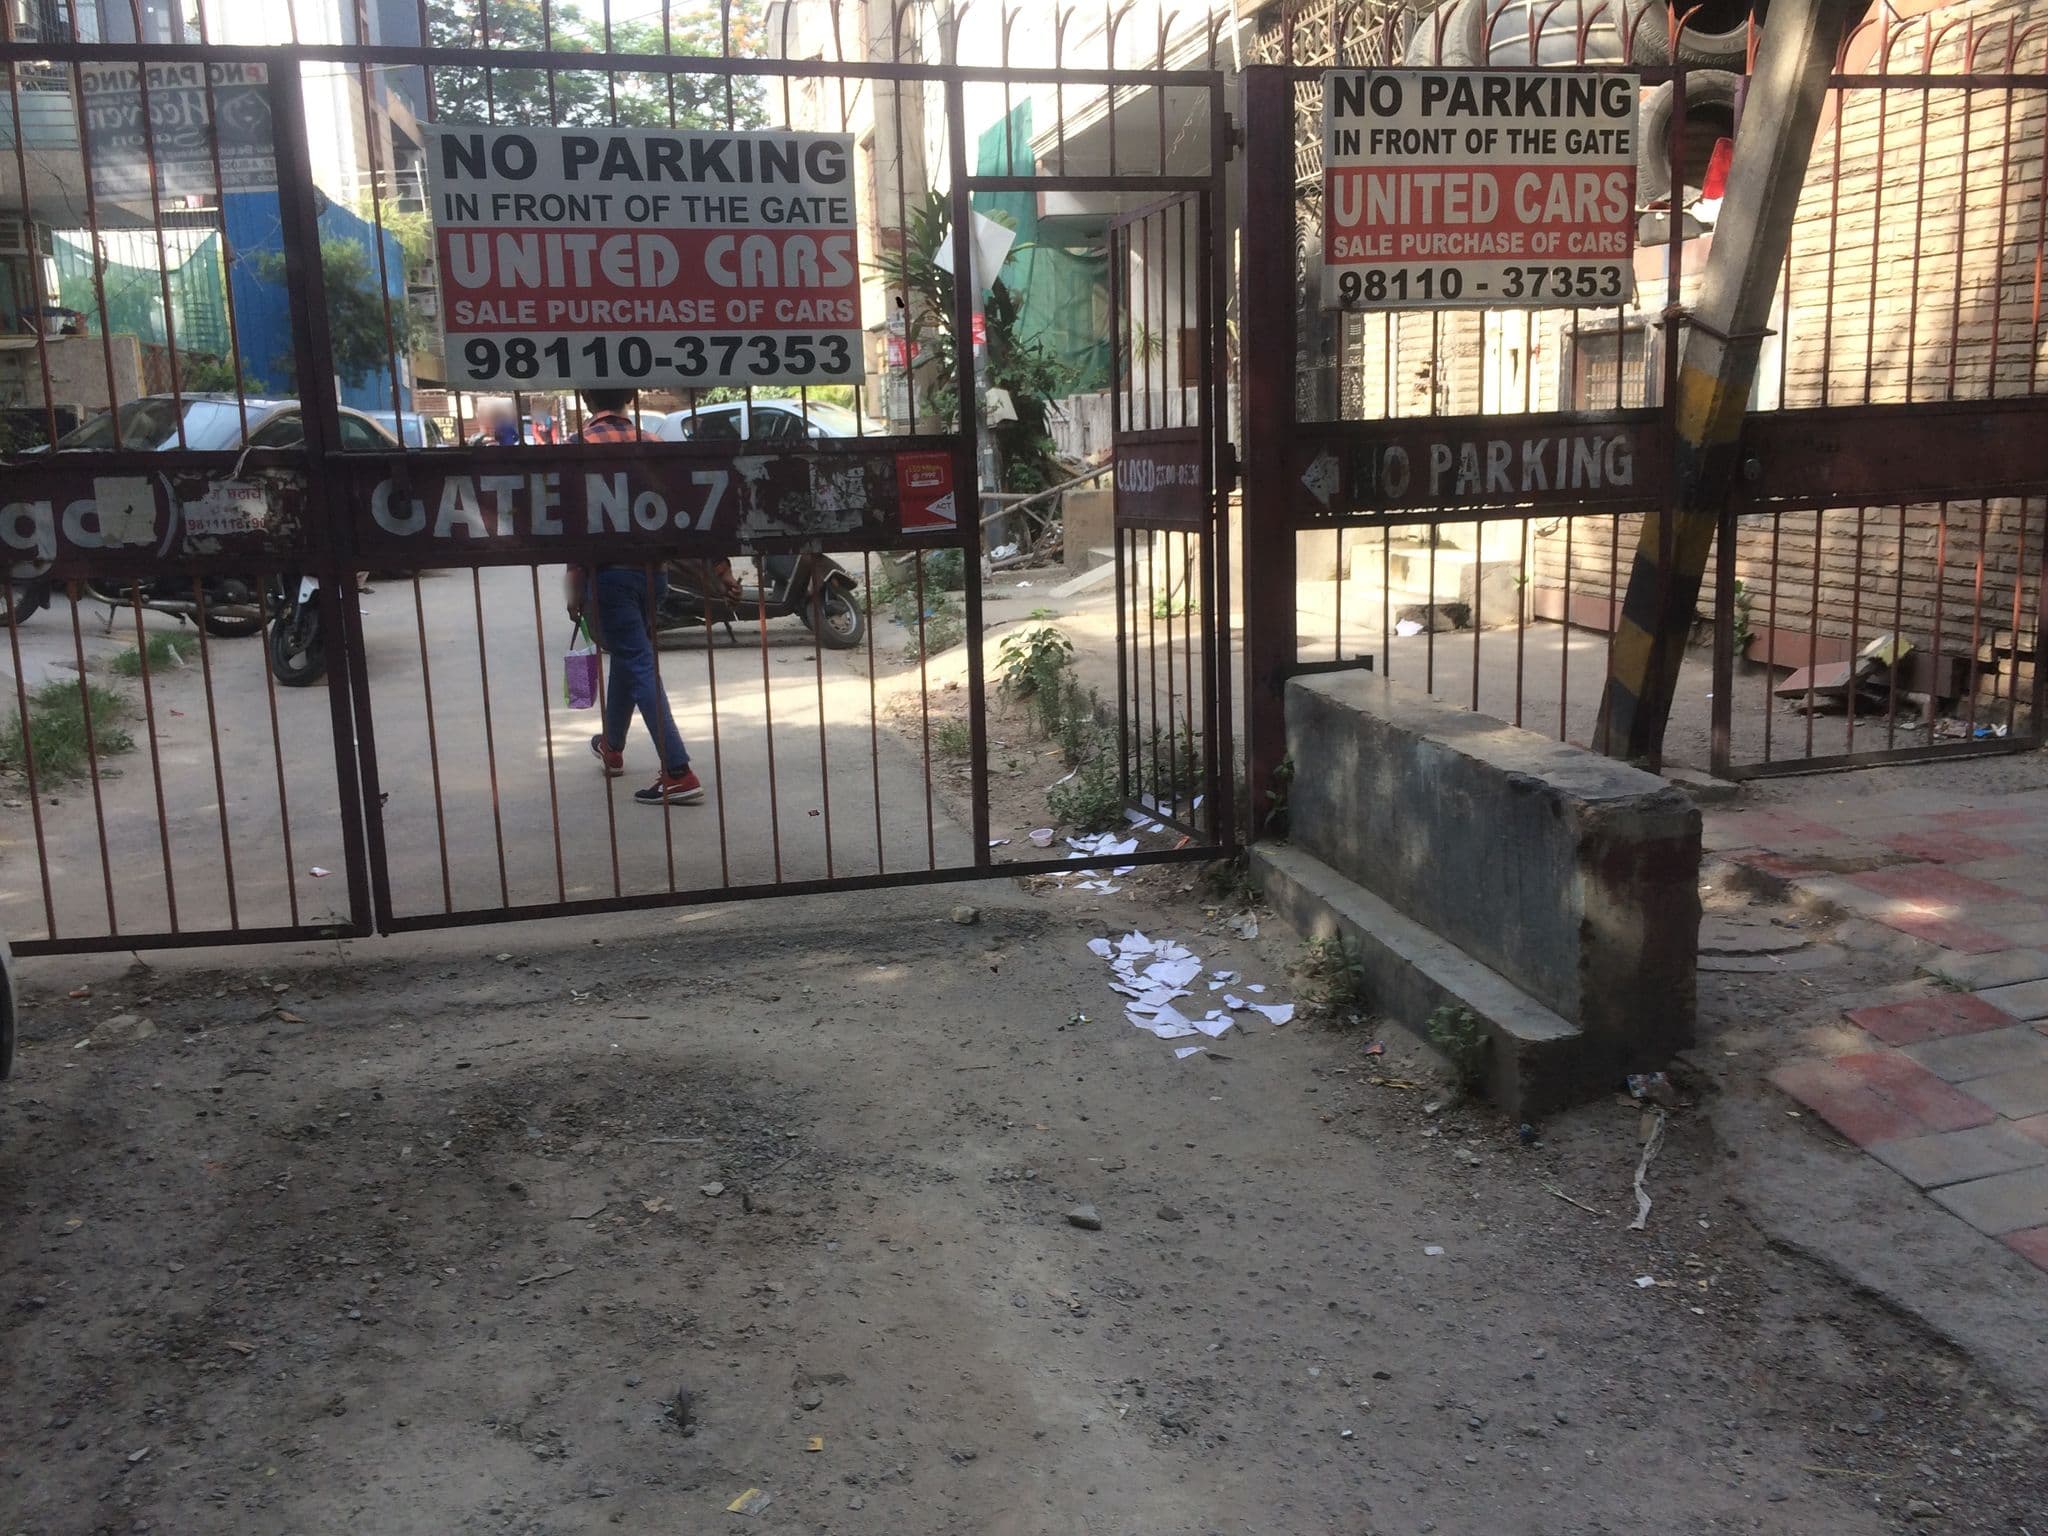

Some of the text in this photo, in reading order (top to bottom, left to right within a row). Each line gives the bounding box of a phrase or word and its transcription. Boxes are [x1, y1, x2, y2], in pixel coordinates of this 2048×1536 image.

[1334, 75, 1631, 118] NO PARKING
[441, 134, 846, 184] NO PARKING
[1334, 128, 1630, 156] IN FRONT OF THE GATE
[444, 193, 848, 224] IN FRONT OF THE GATE
[1334, 172, 1629, 227] UNITED CARS
[448, 232, 854, 289] UNITED CARS
[1334, 231, 1627, 258] SALE PURCHASE OF CARS
[1339, 268, 1463, 303] 98110
[1502, 266, 1622, 298] 37353
[455, 299, 854, 325] SALE PURCHASE OF CARS
[464, 335, 851, 380] 98110-37353
[1117, 459, 1155, 491] CLOSED
[1429, 434, 1633, 497] PARKING
[371, 472, 564, 538] GATE
[935, 502, 951, 510] ACT
